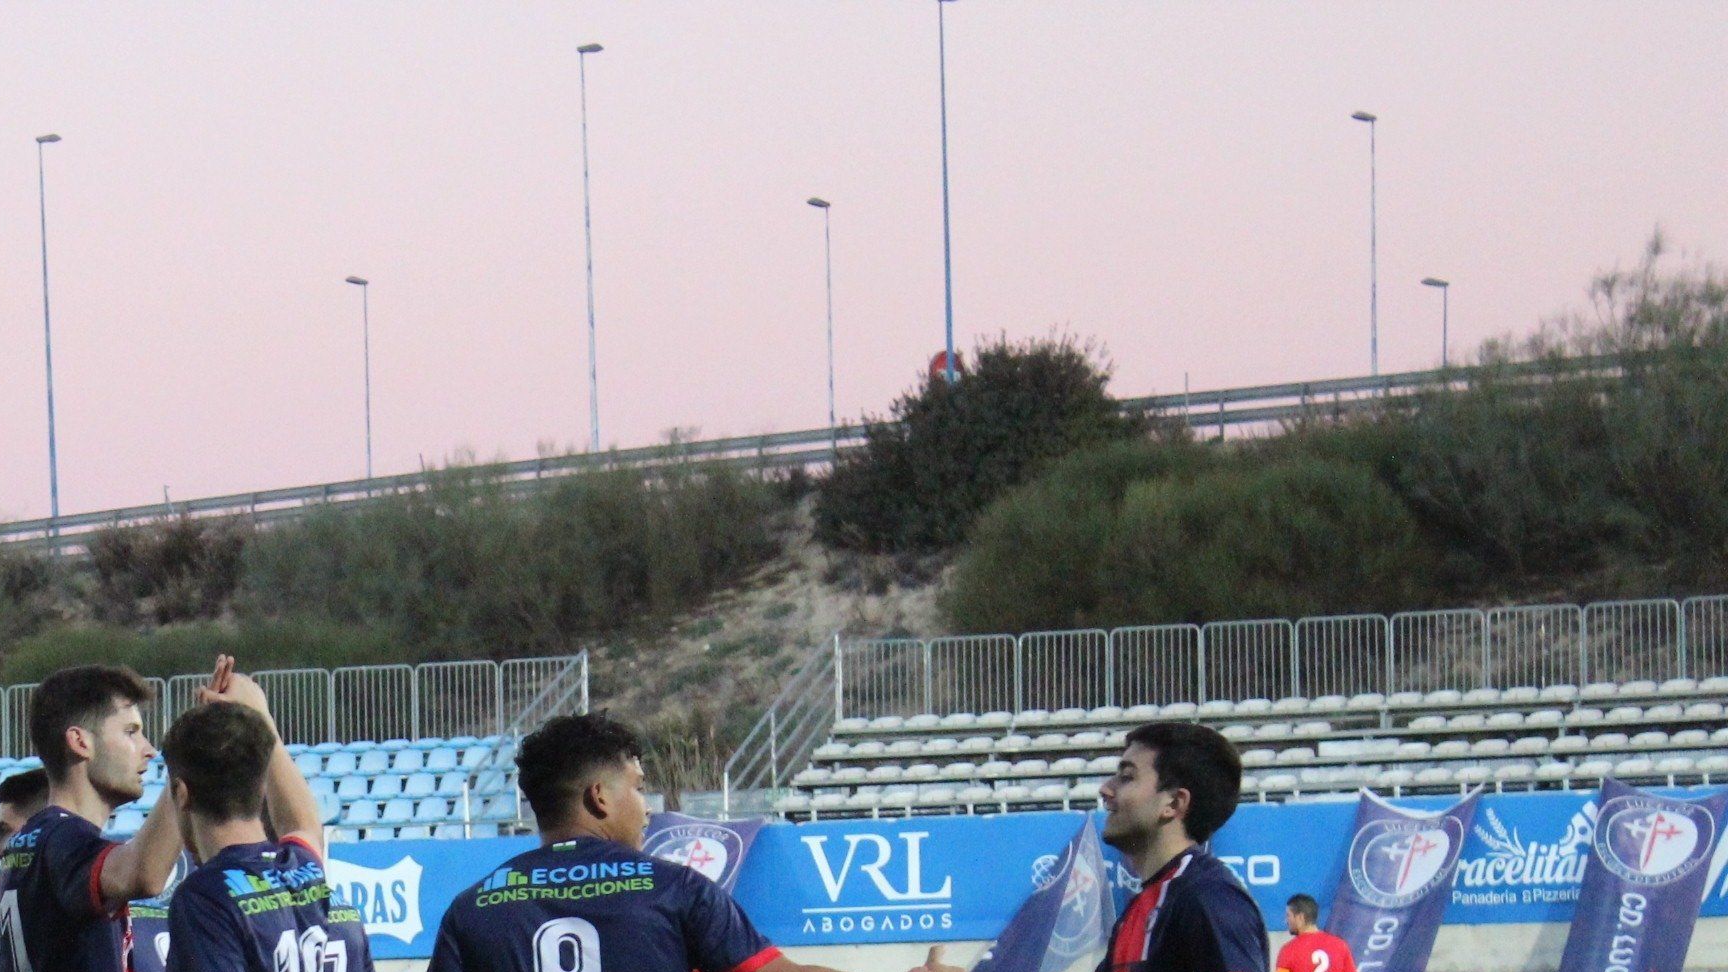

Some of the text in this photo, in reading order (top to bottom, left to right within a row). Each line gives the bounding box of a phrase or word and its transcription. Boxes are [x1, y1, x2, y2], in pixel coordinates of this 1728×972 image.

[531, 861, 655, 885] ECOINSE
[800, 831, 953, 901] VRL
[475, 876, 655, 908] CONSTRUCCIONES
[802, 912, 954, 934] ABOGADOS
